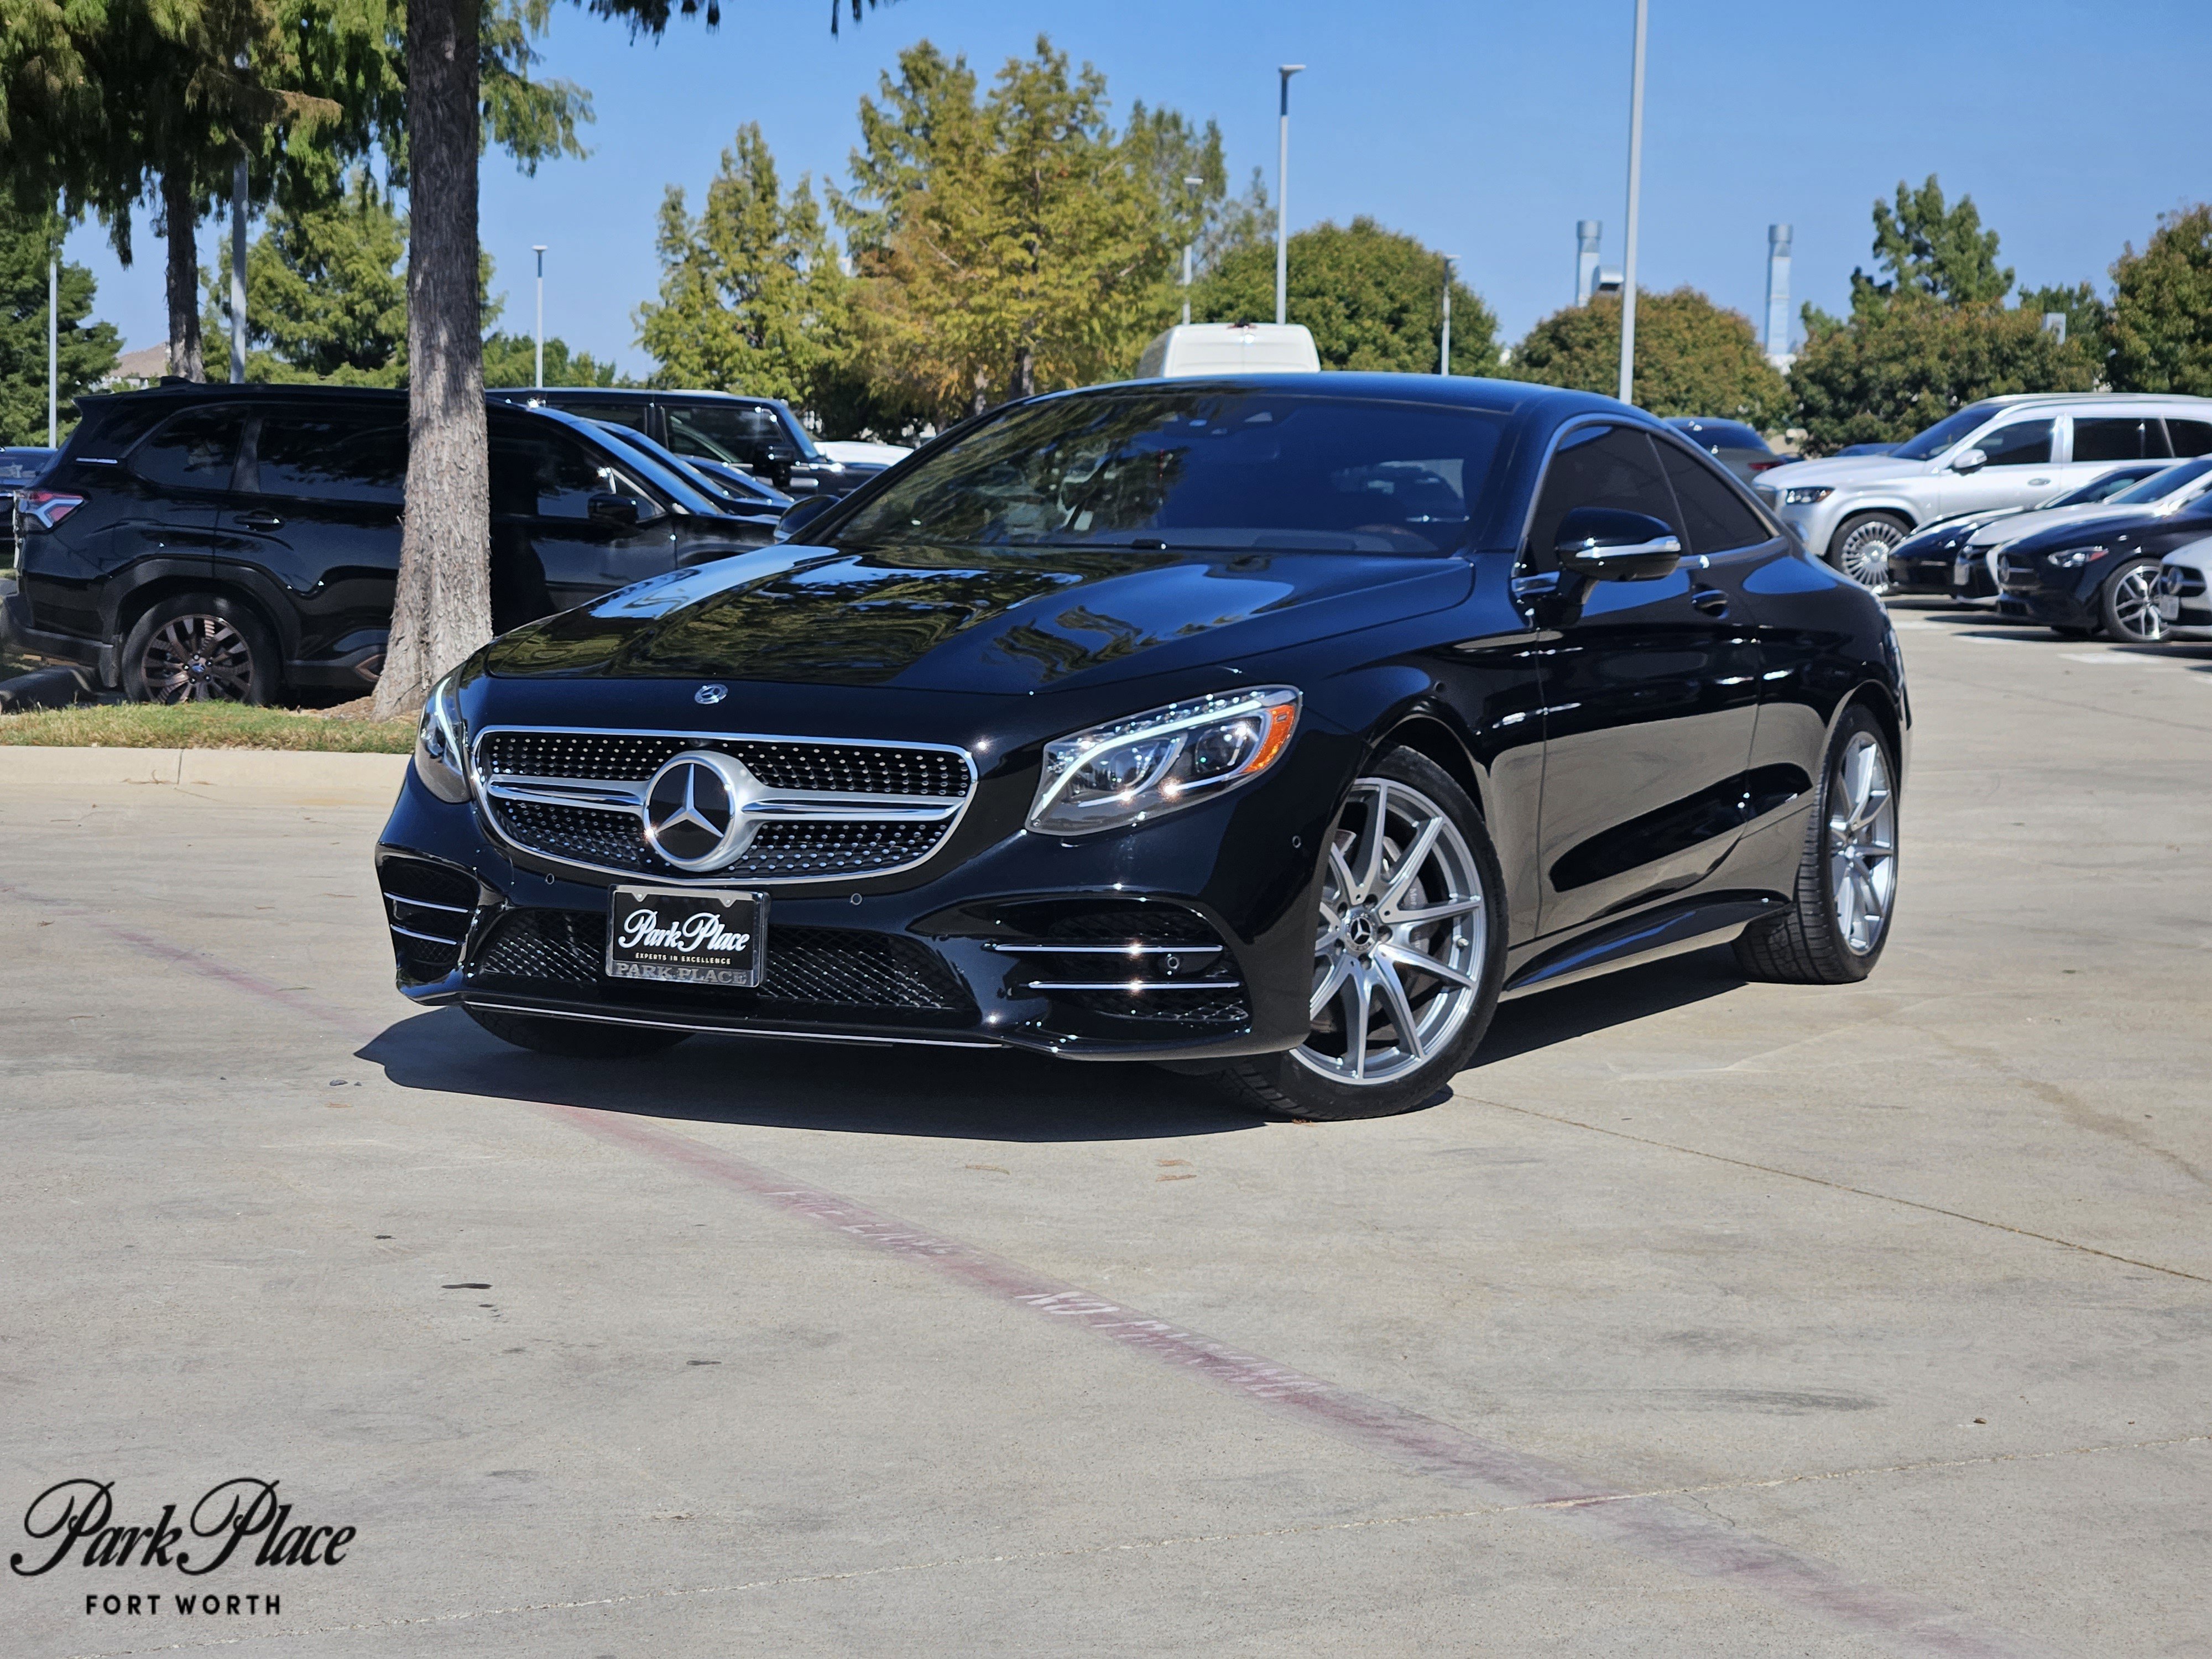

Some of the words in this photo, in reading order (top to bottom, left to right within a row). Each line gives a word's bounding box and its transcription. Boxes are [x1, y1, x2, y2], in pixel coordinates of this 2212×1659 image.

[618, 909, 683, 948] Park
[677, 912, 750, 952] Place
[635, 952, 667, 961] EXPERTS
[681, 956, 731, 965] EXCELLENCE
[616, 963, 672, 979] PARK
[679, 969, 747, 985] PLACE
